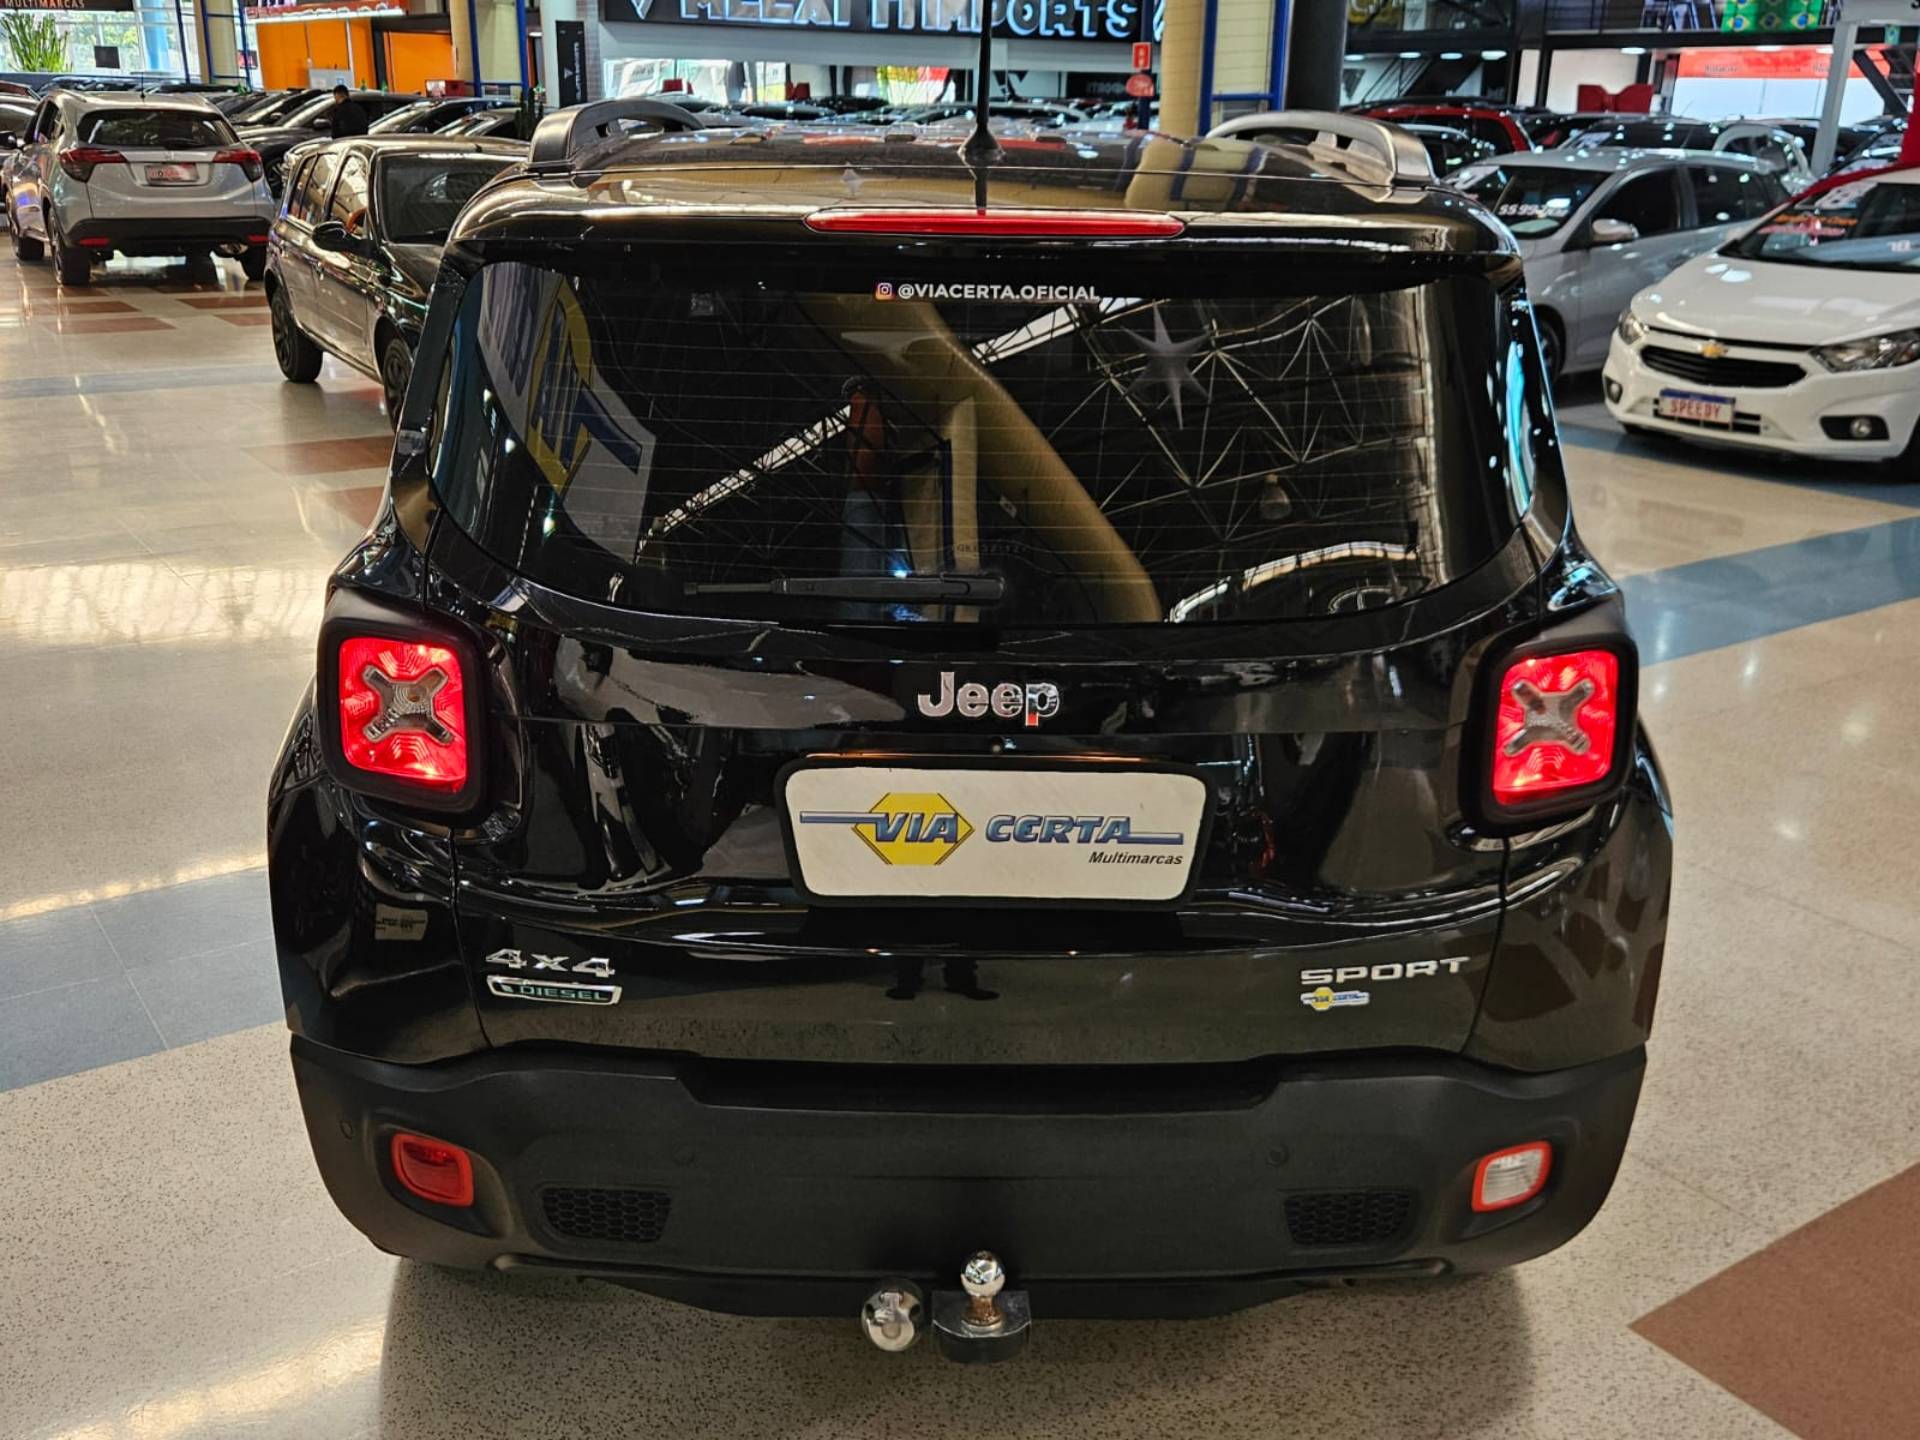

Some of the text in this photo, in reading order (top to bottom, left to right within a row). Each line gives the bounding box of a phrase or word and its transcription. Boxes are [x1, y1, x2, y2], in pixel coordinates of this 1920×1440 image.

[897, 283, 1100, 301] @VIACERTA.OFICIAL
[1671, 400, 1721, 419] SPEEDY
[917, 671, 1060, 727] Jeep
[873, 812, 1132, 845] VIA CERTA
[1088, 850, 1184, 866] Multimarcas
[1300, 956, 1471, 985] SPORT
[520, 985, 609, 1001] DIESEL
